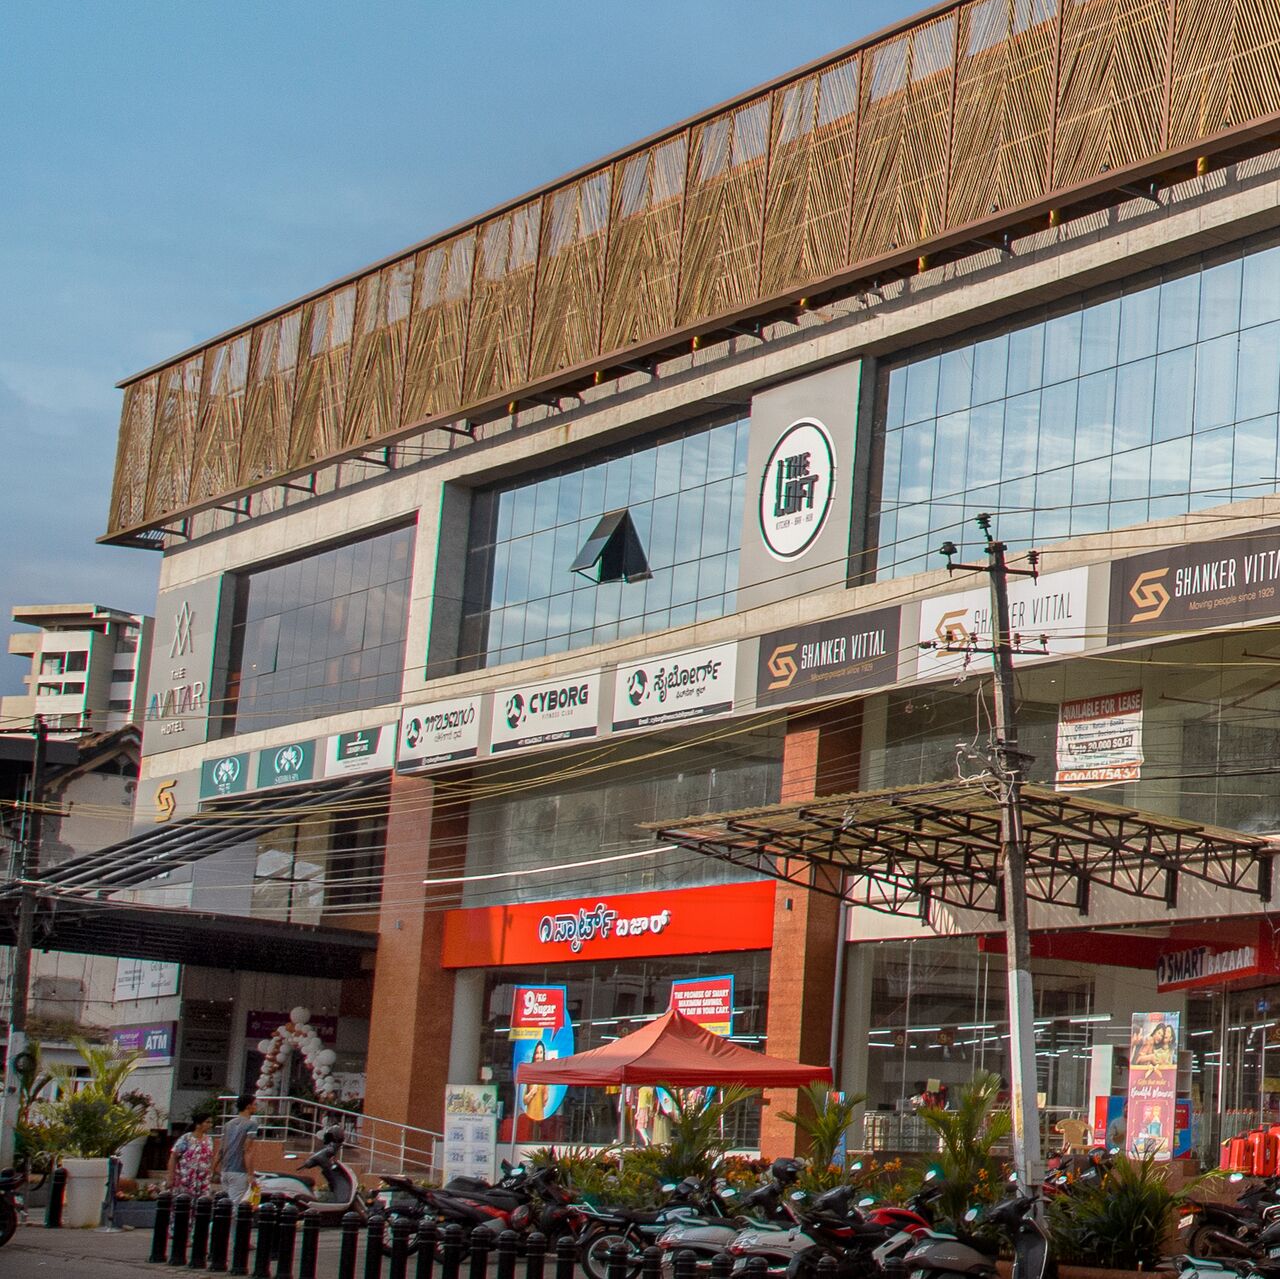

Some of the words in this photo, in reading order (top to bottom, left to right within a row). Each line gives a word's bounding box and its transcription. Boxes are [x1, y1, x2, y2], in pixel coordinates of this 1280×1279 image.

[784, 451, 812, 480] THE
[774, 459, 820, 518] LOFT
[1174, 558, 1237, 598] SHANKER
[974, 600, 1026, 635] SHER
[1032, 591, 1073, 625] VITTAL
[1188, 599, 1213, 612] Moving
[1213, 594, 1238, 607] people
[1238, 591, 1257, 602] since
[1257, 586, 1276, 600] 1929
[800, 636, 847, 671] SHANKER
[851, 629, 887, 661] VITTAL
[145, 681, 206, 721] AVATAR
[528, 683, 589, 714] CYBORG
[1062, 700, 1099, 721] AVAILABLE
[1100, 698, 1116, 715] FOR
[1119, 693, 1140, 712] LEASE
[1167, 946, 1207, 982] SMART
[1207, 945, 1256, 976] BAZAAR
[523, 990, 536, 1016] 9
[533, 1003, 557, 1017] Sugar
[144, 1034, 168, 1051] ATM
